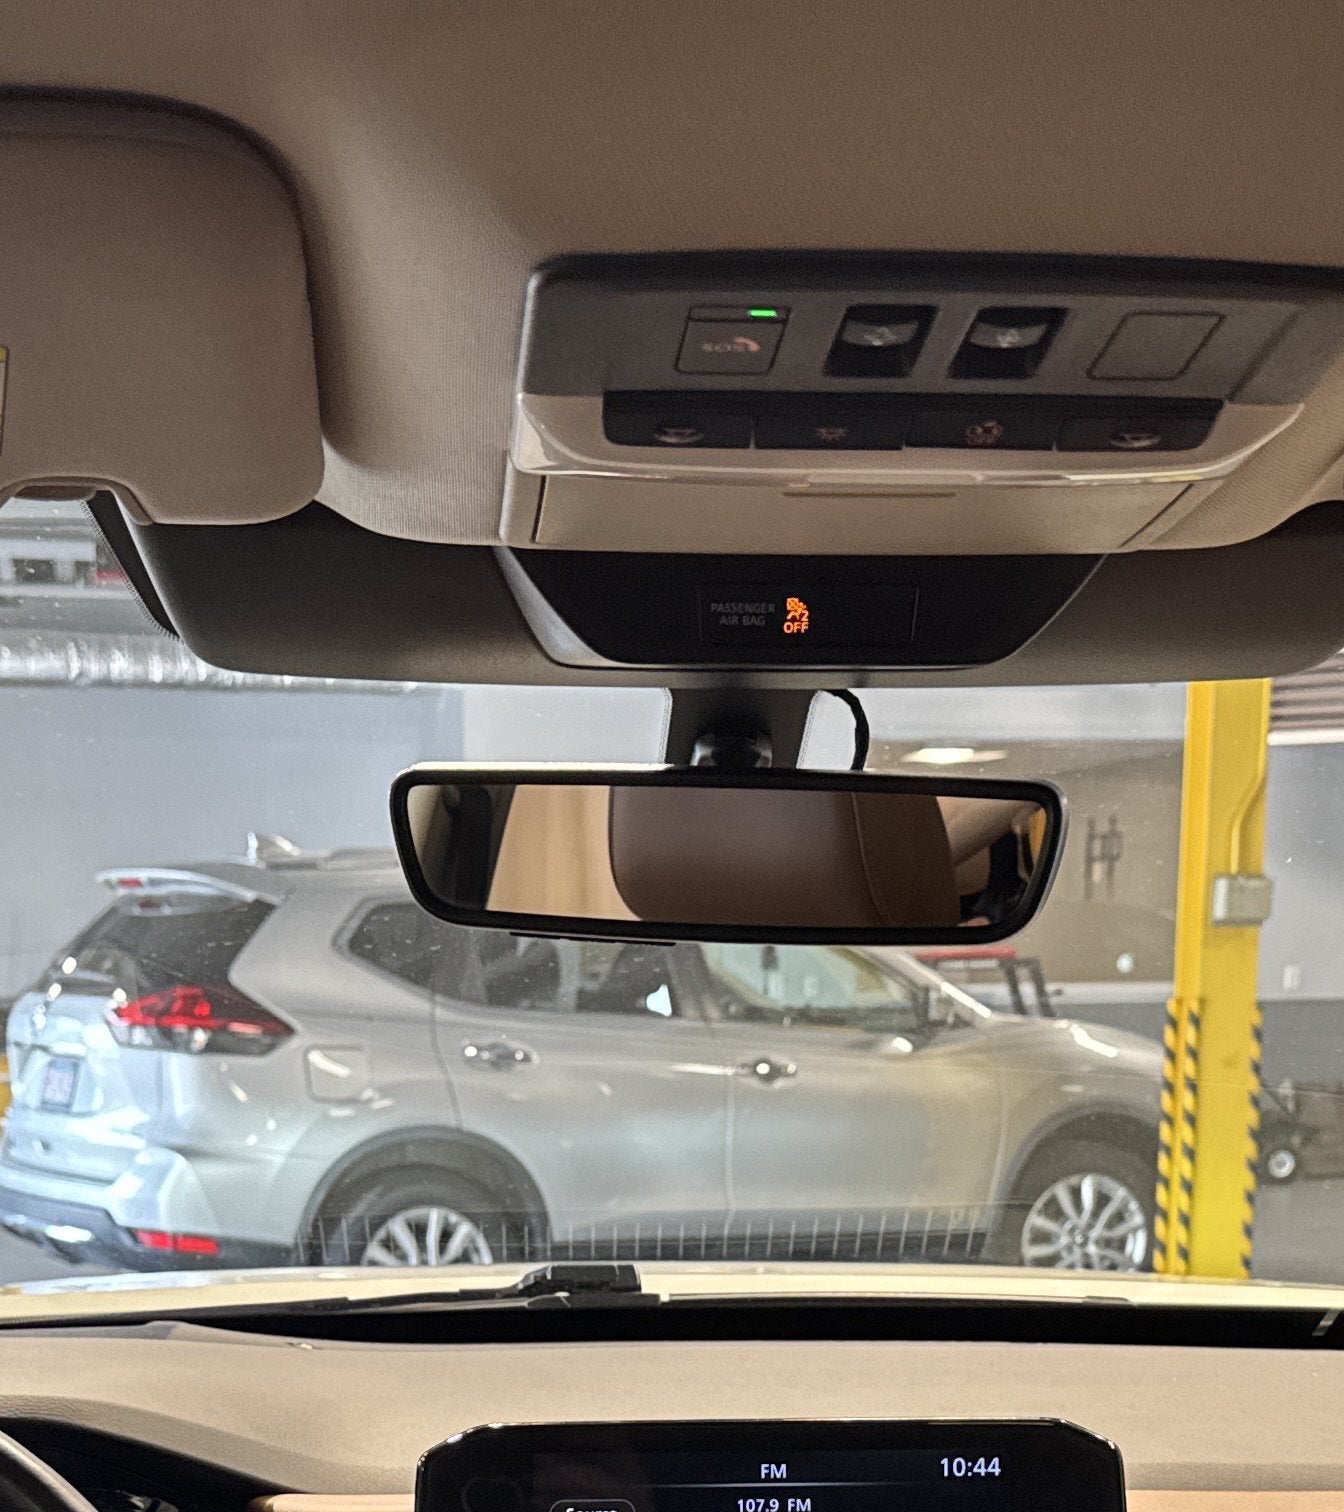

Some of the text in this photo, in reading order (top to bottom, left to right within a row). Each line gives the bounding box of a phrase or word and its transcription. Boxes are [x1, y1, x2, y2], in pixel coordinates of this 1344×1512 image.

[711, 602, 776, 613] PASSENGER
[719, 614, 766, 626] AIR BAG
[783, 621, 809, 633] OFF
[760, 1464, 787, 1480] FM
[940, 1457, 1001, 1478] 10:44
